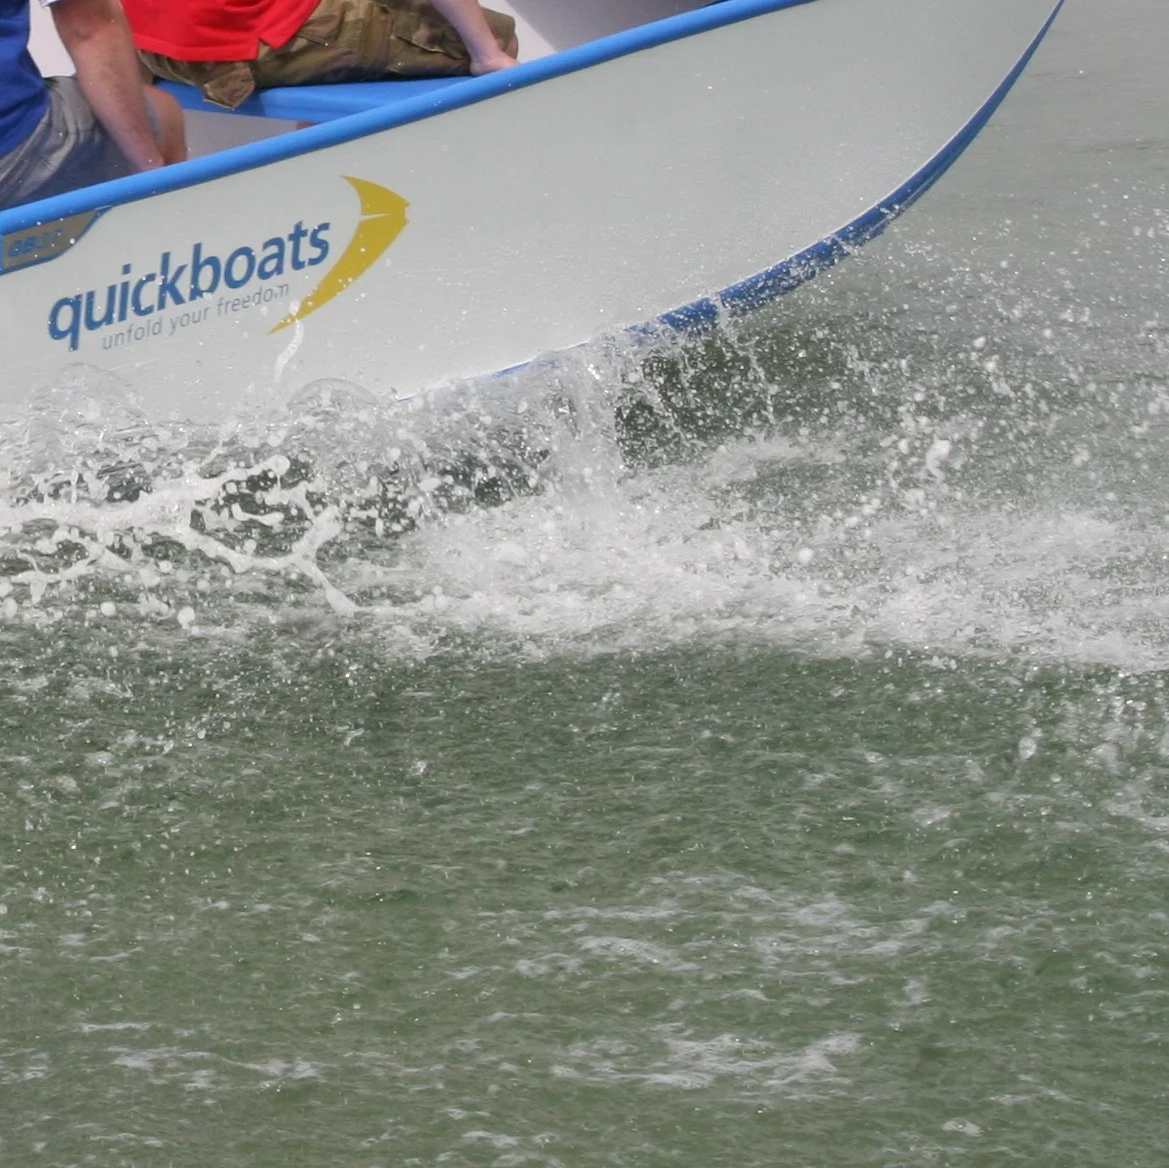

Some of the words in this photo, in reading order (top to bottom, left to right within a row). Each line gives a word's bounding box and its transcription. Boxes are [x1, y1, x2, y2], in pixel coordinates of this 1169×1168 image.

[48, 220, 330, 352] quickboats
[102, 320, 163, 350] unfold
[168, 307, 210, 336] your
[217, 283, 289, 316] freedom
